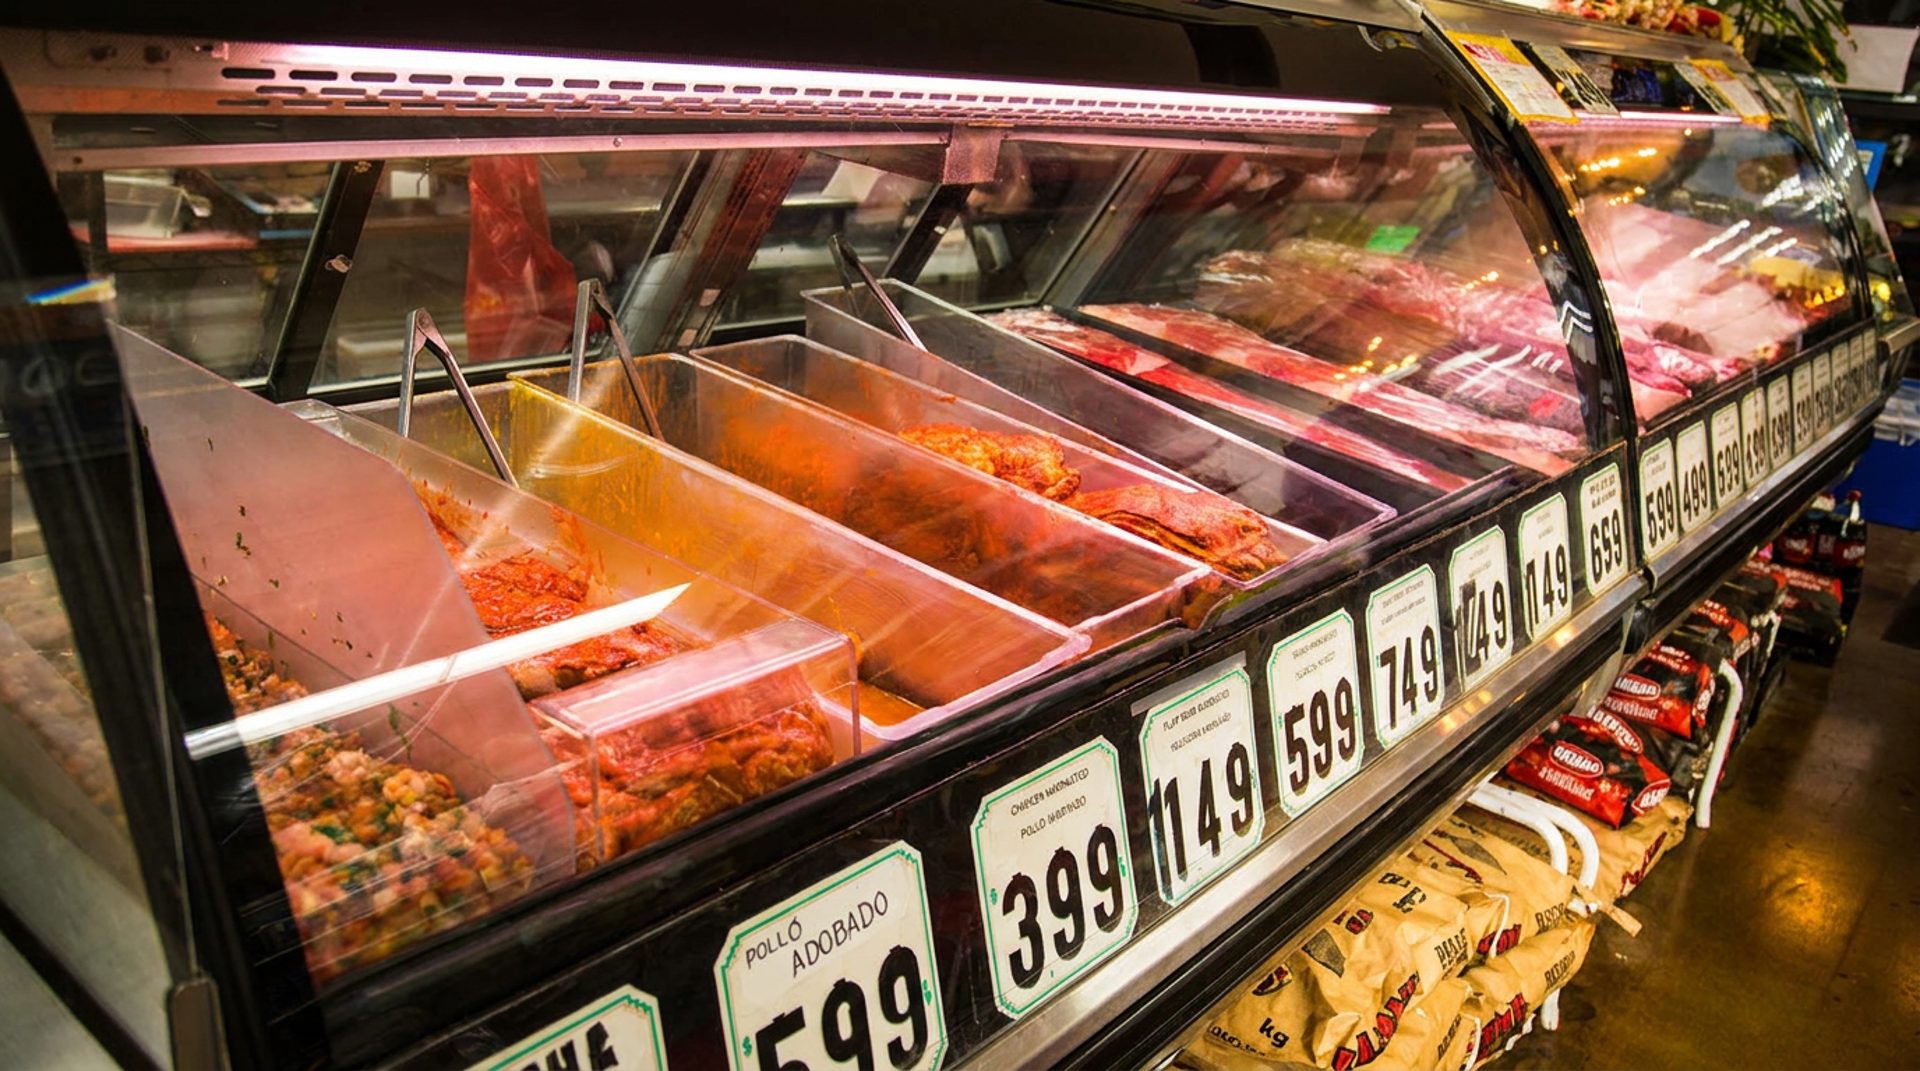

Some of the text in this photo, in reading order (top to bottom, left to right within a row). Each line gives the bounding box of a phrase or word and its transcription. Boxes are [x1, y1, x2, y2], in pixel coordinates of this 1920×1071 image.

[1591, 508, 1622, 584] 659
[1646, 481, 1675, 547] 599
[1379, 625, 1438, 731] 749
[1285, 676, 1356, 796] 599
[1150, 741, 1255, 900] 1149
[793, 891, 888, 978] ADOBADO
[1002, 824, 1123, 988] 399
[755, 944, 928, 1071] 599
[1258, 1017, 1290, 1049] kg
